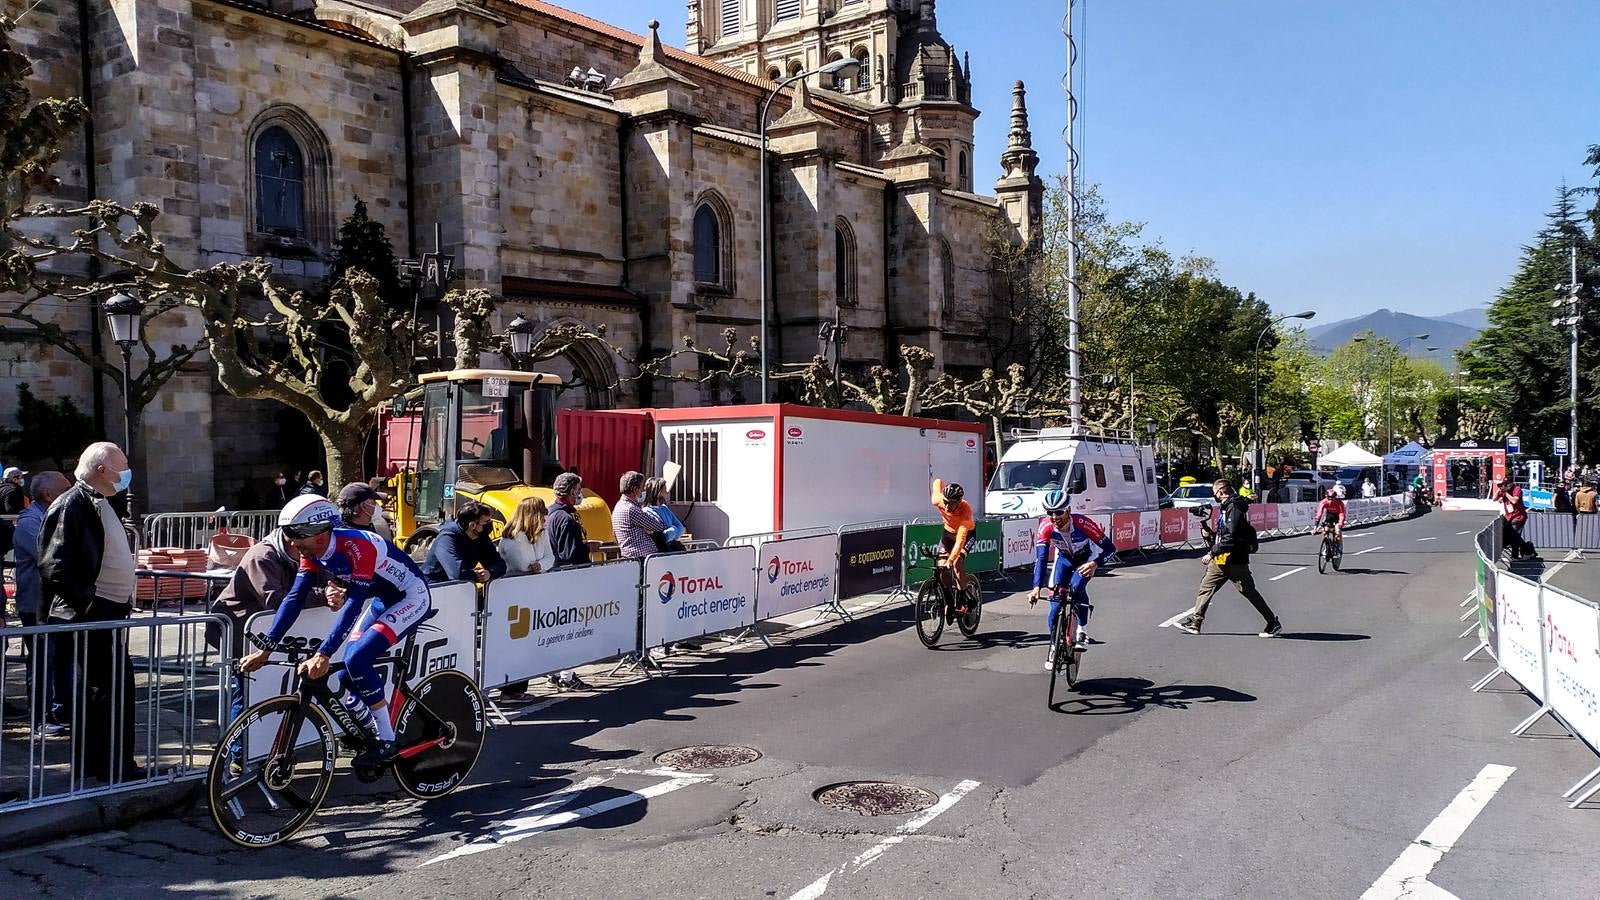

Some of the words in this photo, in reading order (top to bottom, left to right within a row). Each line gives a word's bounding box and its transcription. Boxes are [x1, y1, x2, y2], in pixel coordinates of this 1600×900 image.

[444, 486, 454, 497] 64
[1007, 537, 1030, 556] Express
[782, 559, 815, 575] TOTAL
[678, 575, 724, 595] TOTAL
[780, 578, 803, 597] direct
[803, 573, 830, 592] energie
[393, 602, 415, 617] TOTAL
[532, 599, 621, 631] Ikolansports
[677, 597, 708, 620] direct
[709, 592, 746, 614] energie
[537, 636, 545, 647] La
[428, 652, 458, 674] 2000
[463, 684, 482, 732] URSUS
[221, 711, 260, 759] URSUS
[320, 724, 332, 772] URSUS
[416, 772, 460, 793] URSUS
[235, 830, 280, 844] URSUS
